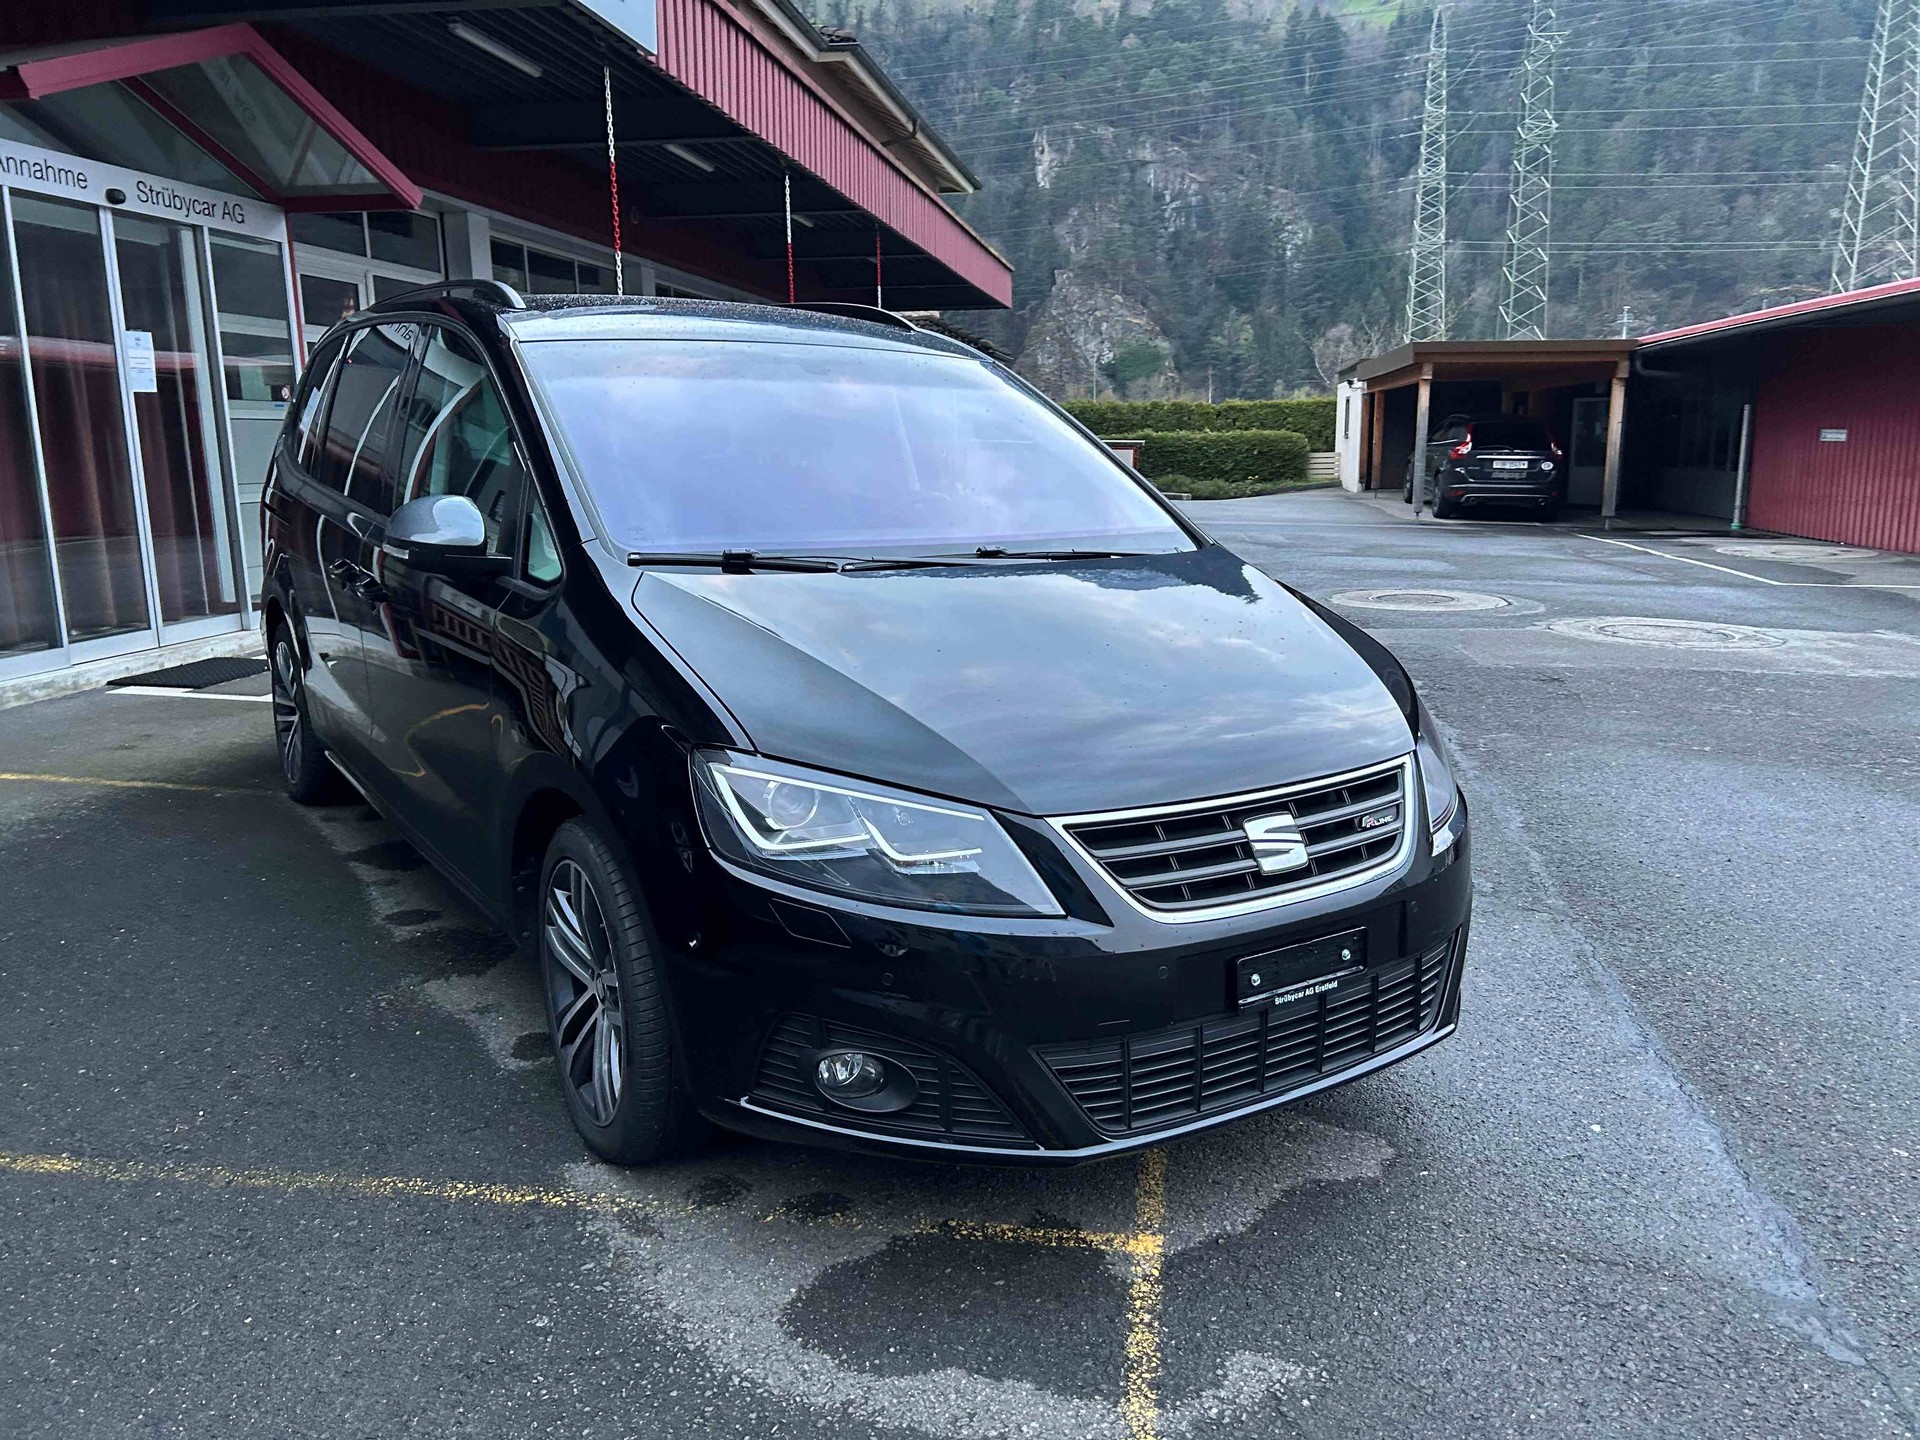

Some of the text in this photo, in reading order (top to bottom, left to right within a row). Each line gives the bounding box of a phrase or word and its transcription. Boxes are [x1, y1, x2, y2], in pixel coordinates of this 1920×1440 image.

[136, 180, 246, 225] Strübycar AG
[1274, 980, 1338, 1005] Strübycar AG Erstfeld
